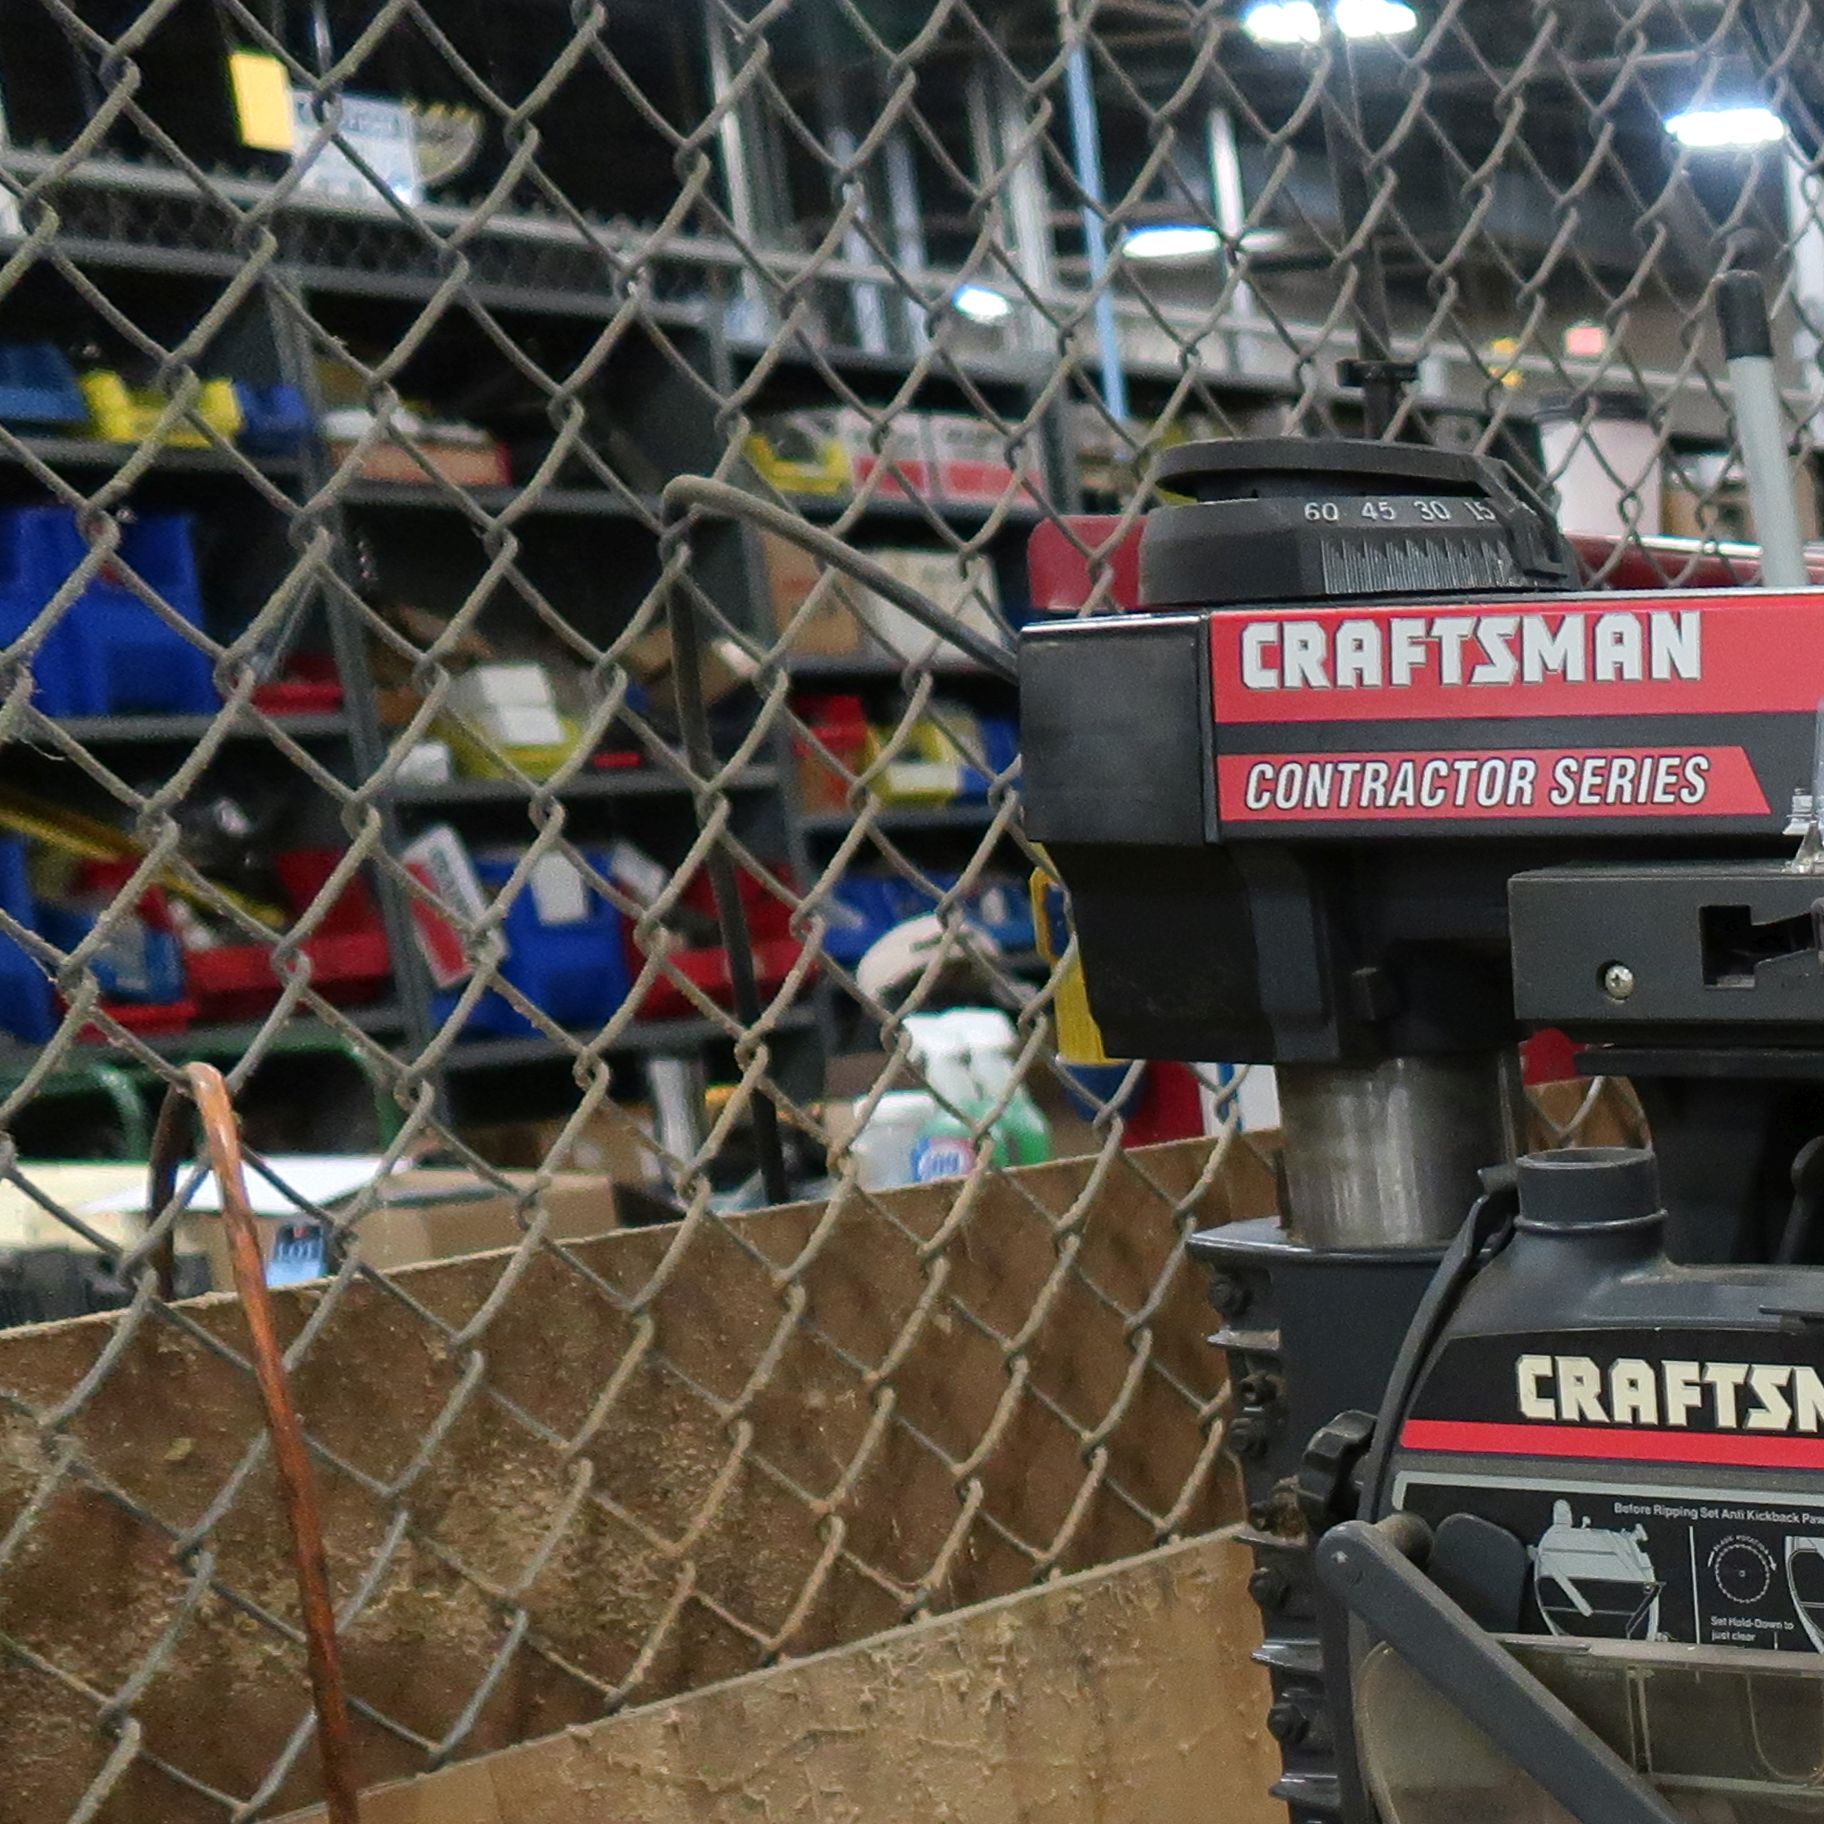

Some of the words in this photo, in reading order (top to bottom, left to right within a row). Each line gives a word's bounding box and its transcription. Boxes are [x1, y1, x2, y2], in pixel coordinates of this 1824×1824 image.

[1303, 502, 1339, 522] 60
[1360, 500, 1398, 521] 45
[1413, 500, 1451, 520] 30
[1464, 501, 1497, 521] 15
[1239, 609, 1701, 691] CRAFTSMAN
[1243, 755, 1537, 811] CONTRACTOR
[1548, 753, 1710, 806] SERIES
[1613, 1502, 1651, 1515] Before
[1653, 1504, 1699, 1520] Ripping
[1700, 1506, 1720, 1519] Set
[1747, 1509, 1800, 1524] Kickback
